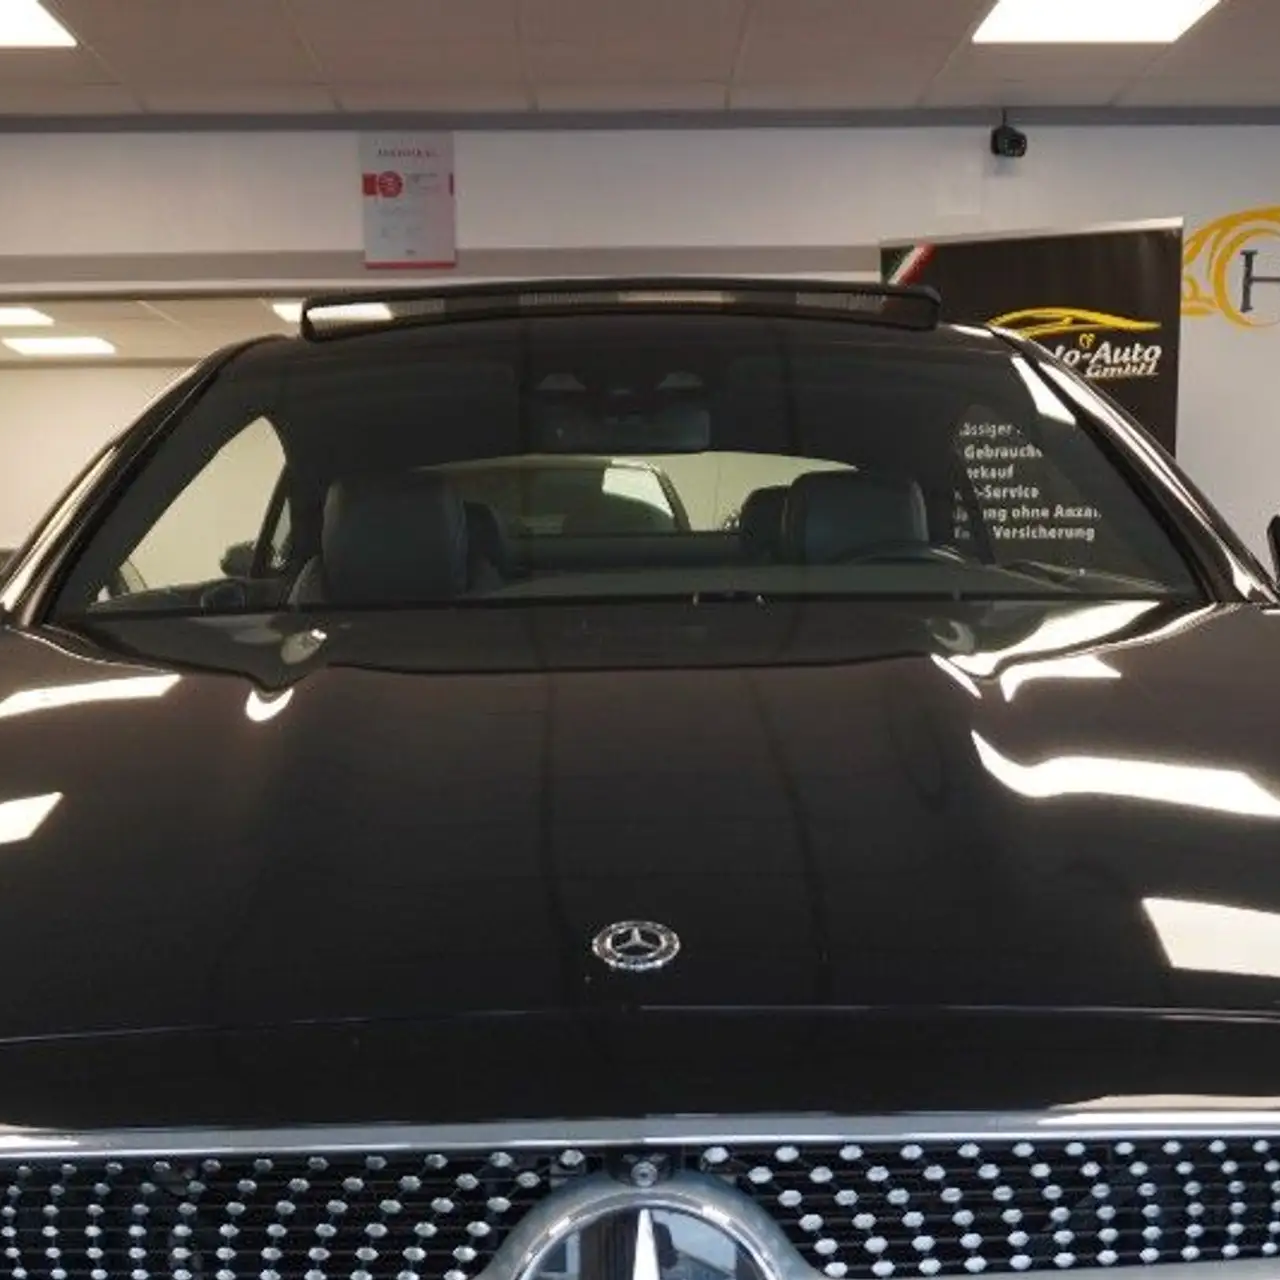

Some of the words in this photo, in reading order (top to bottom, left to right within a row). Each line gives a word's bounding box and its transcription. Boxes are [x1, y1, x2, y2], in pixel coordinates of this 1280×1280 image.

[1054, 341, 1163, 368] lo-Auto
[1012, 504, 1050, 519] ohne
[992, 524, 1096, 541] Versicherung
